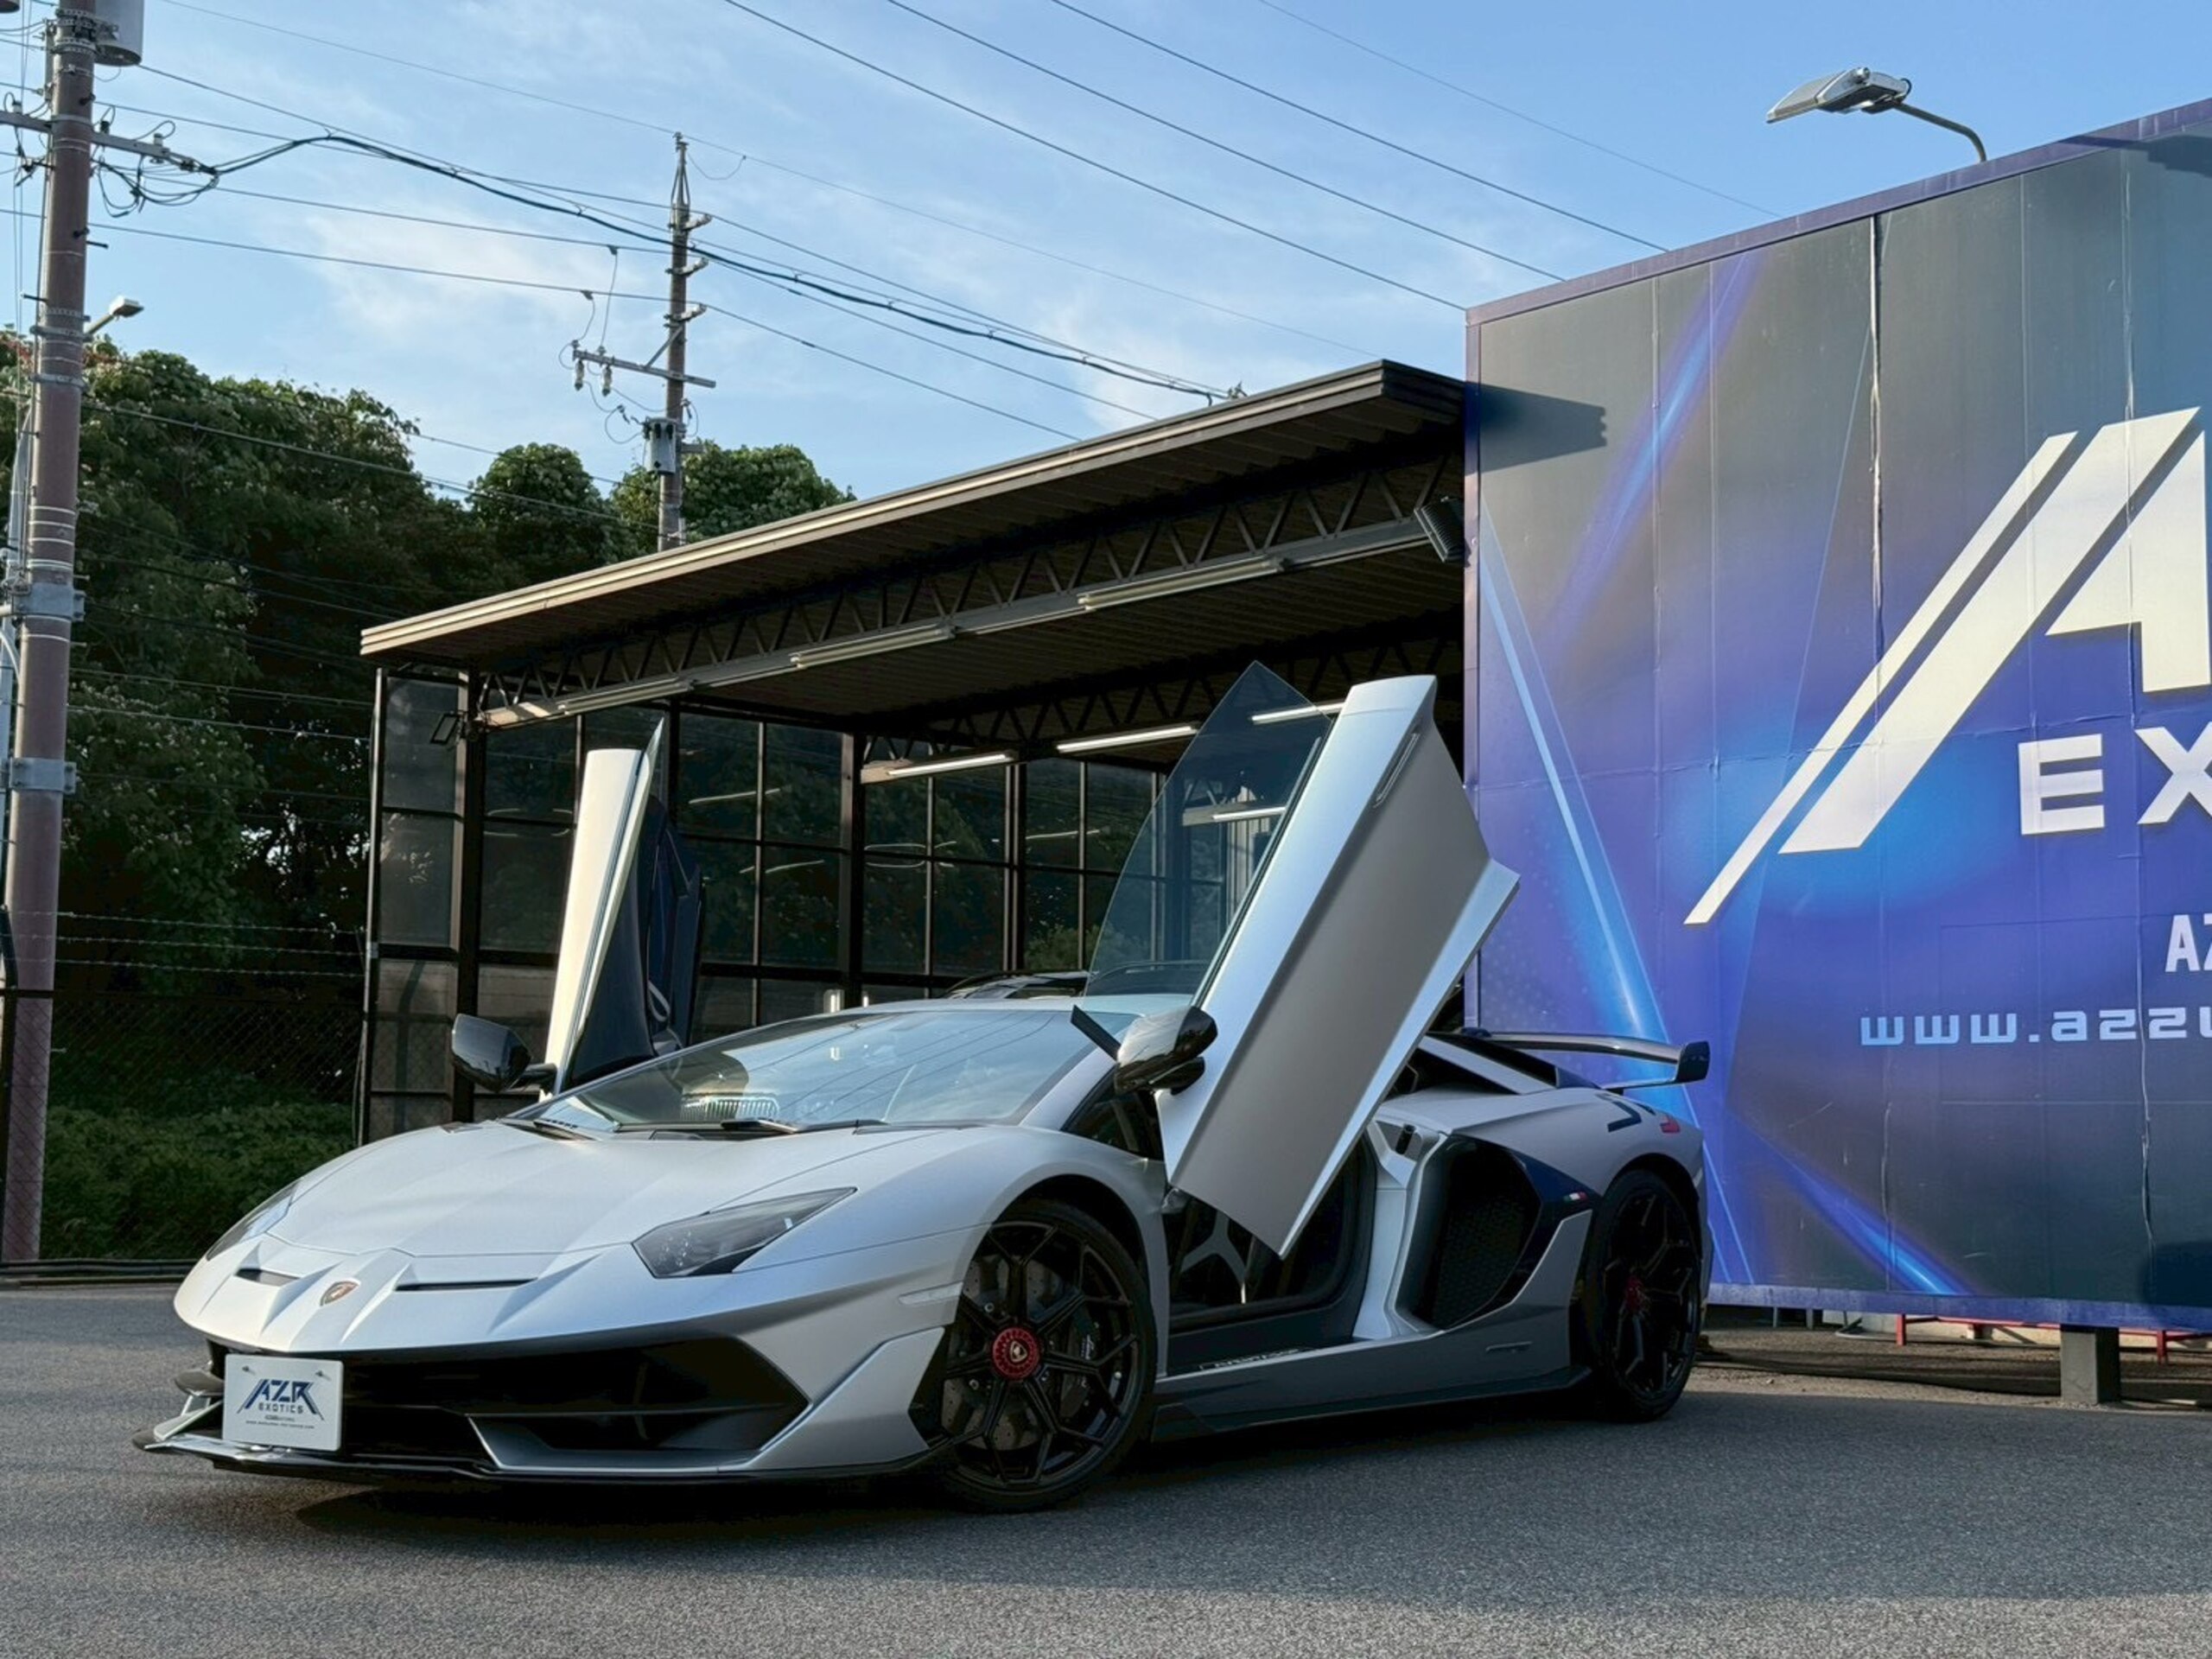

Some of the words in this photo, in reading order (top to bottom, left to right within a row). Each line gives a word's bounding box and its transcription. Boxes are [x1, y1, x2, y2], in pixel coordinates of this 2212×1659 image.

[2018, 721, 2212, 836] EX
[2164, 912, 2212, 973] A
[236, 1378, 325, 1421] AZR
[257, 1402, 304, 1414] EXOTICS
